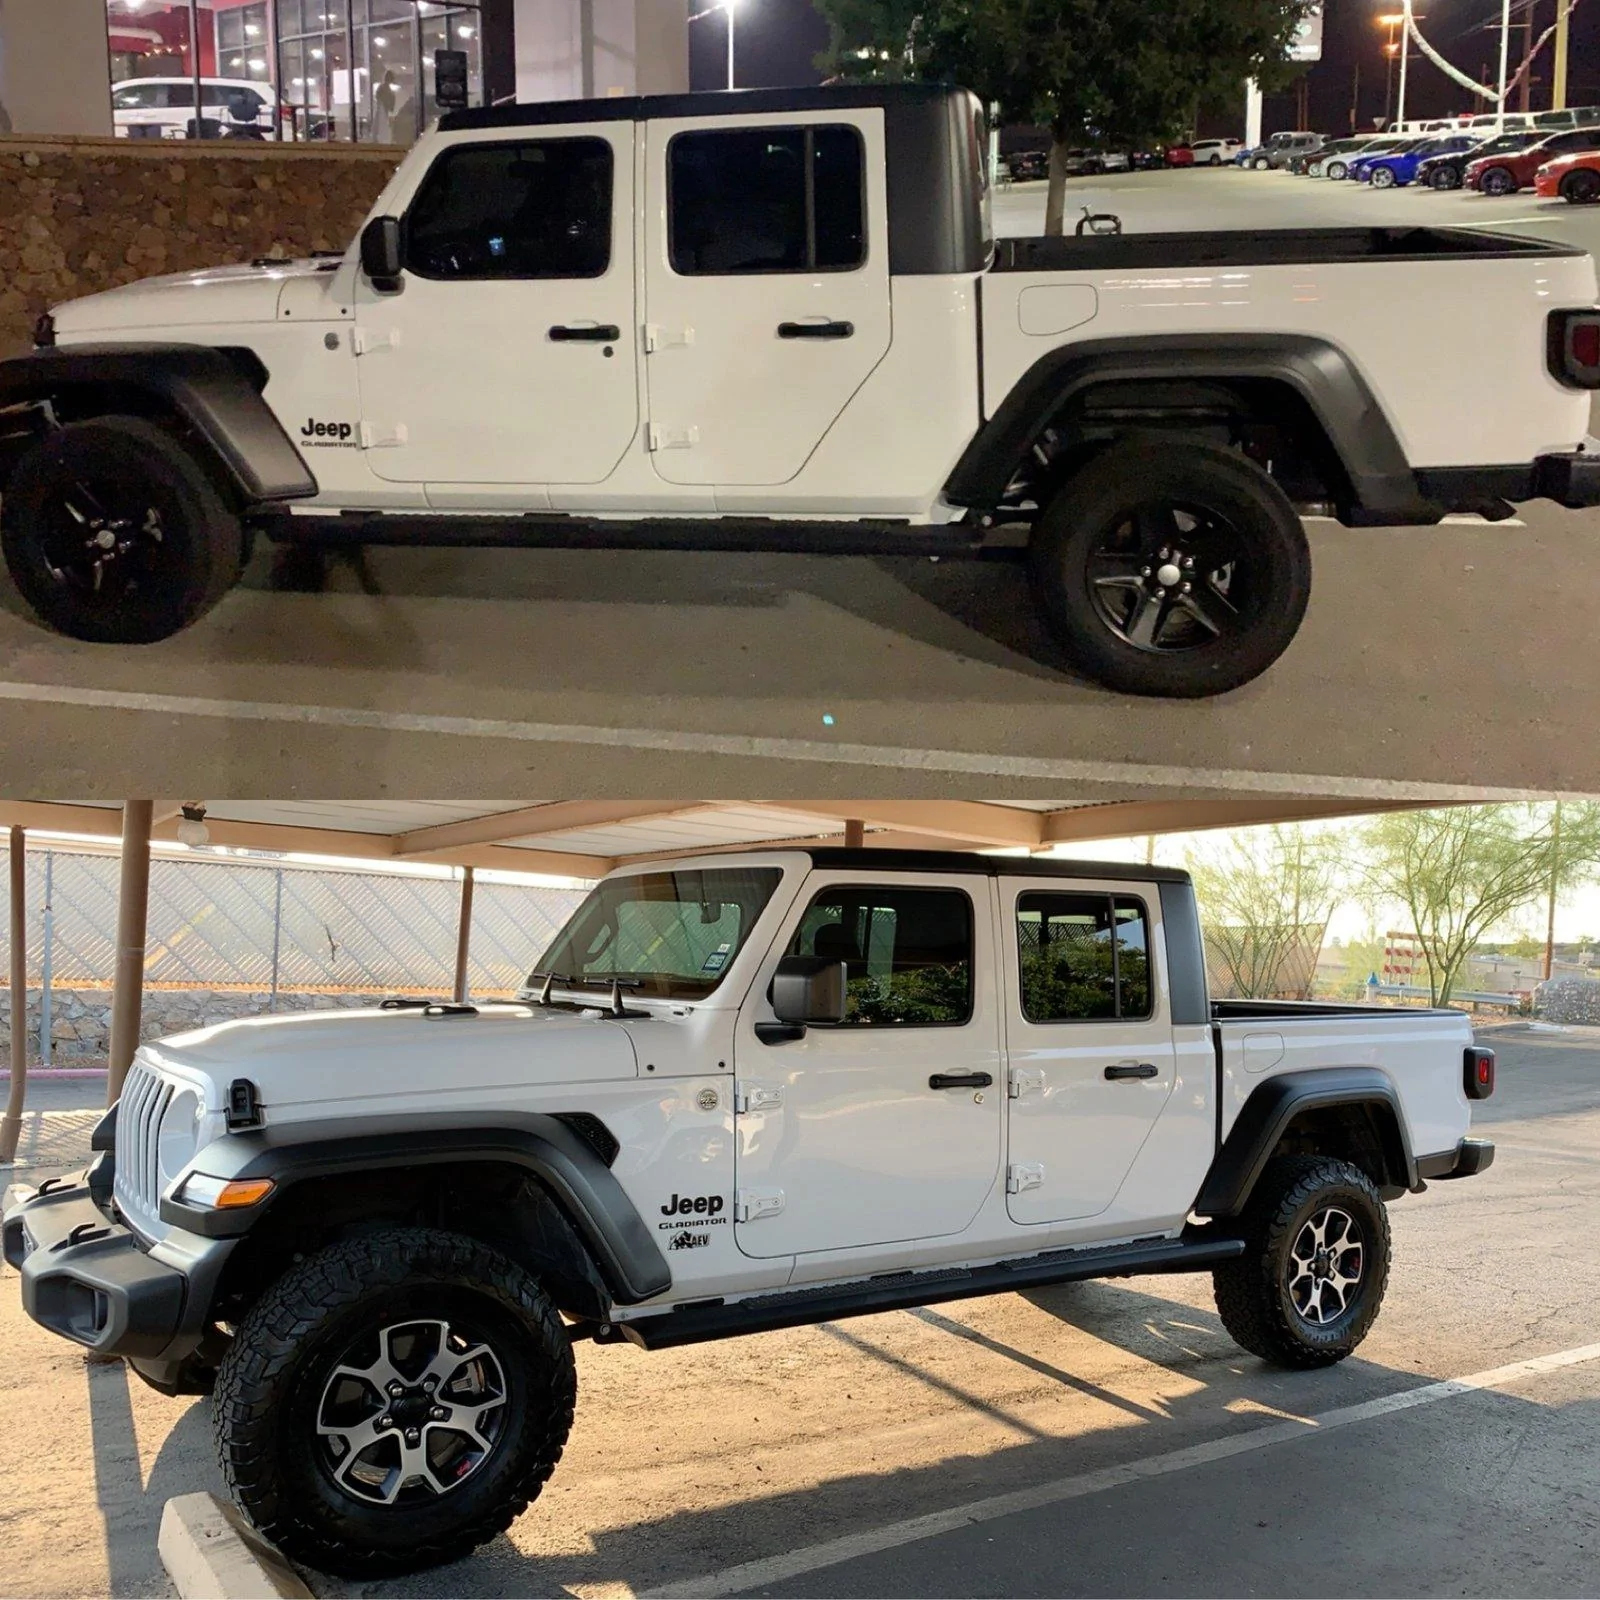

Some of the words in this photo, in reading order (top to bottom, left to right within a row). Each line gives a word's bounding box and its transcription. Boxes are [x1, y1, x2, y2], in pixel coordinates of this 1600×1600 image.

[301, 417, 351, 440] Jeep
[661, 1194, 723, 1216] Jeep
[658, 1217, 727, 1230] GLADIATOR
